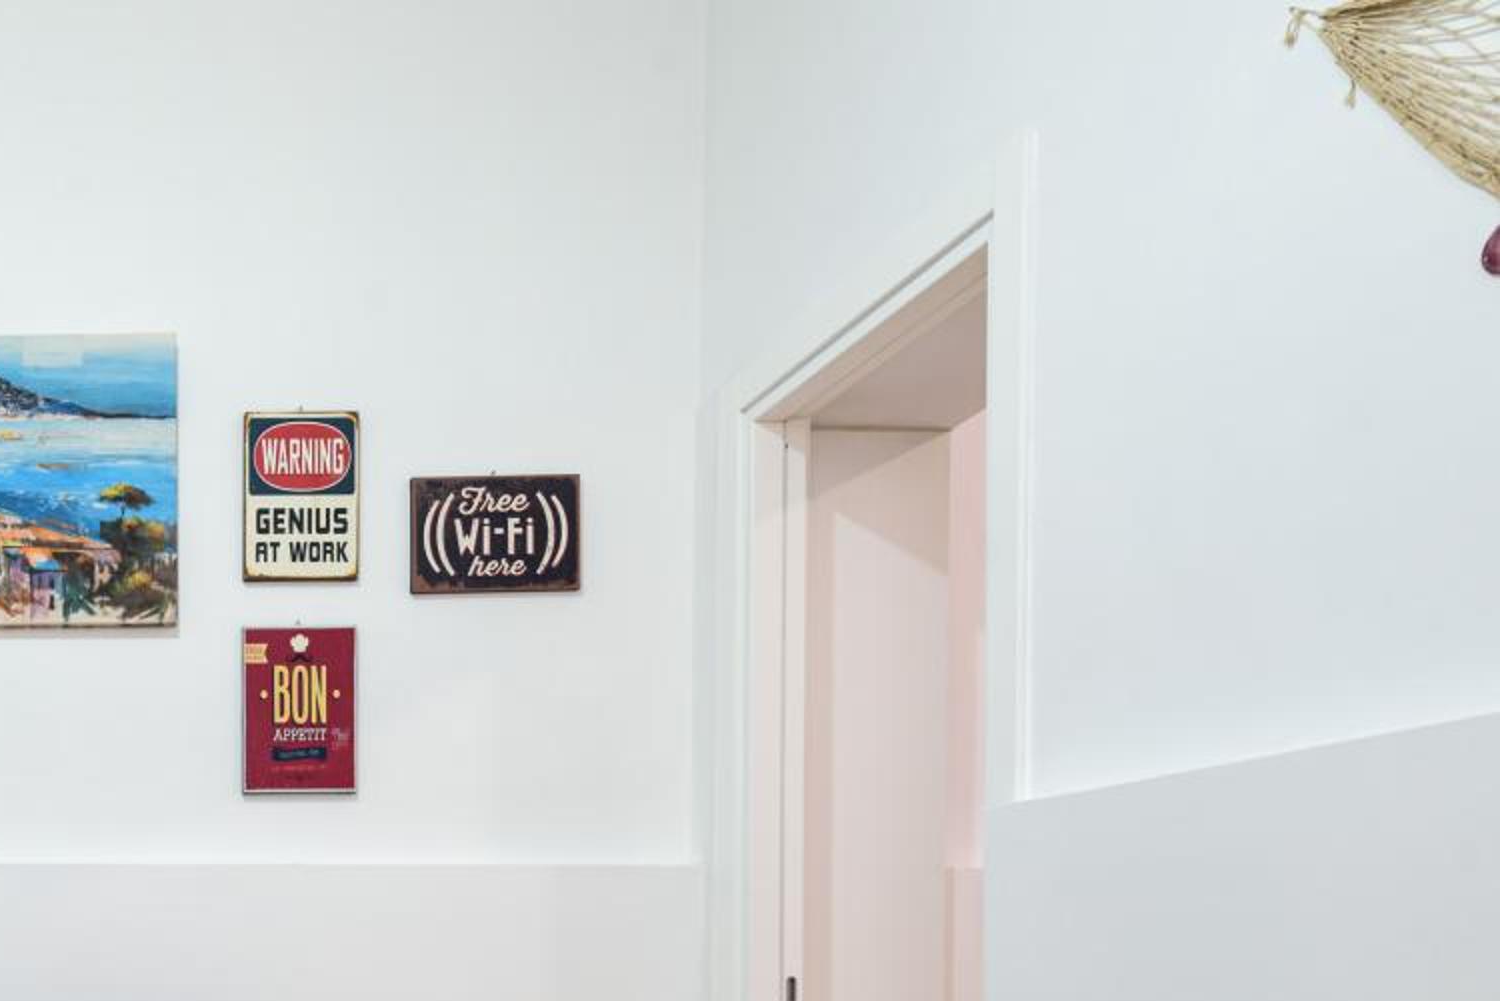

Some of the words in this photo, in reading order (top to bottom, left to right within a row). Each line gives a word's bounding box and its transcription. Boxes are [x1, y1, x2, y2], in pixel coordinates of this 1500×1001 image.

[261, 437, 346, 475] WARNING
[457, 486, 531, 516] Free
[256, 507, 349, 535] GENIUS
[453, 517, 535, 556] Wi-Fi
[255, 541, 281, 563] AT
[289, 541, 349, 563] WORK
[466, 555, 528, 577] here
[273, 664, 328, 726] BON
[273, 727, 327, 741] APPETIT
